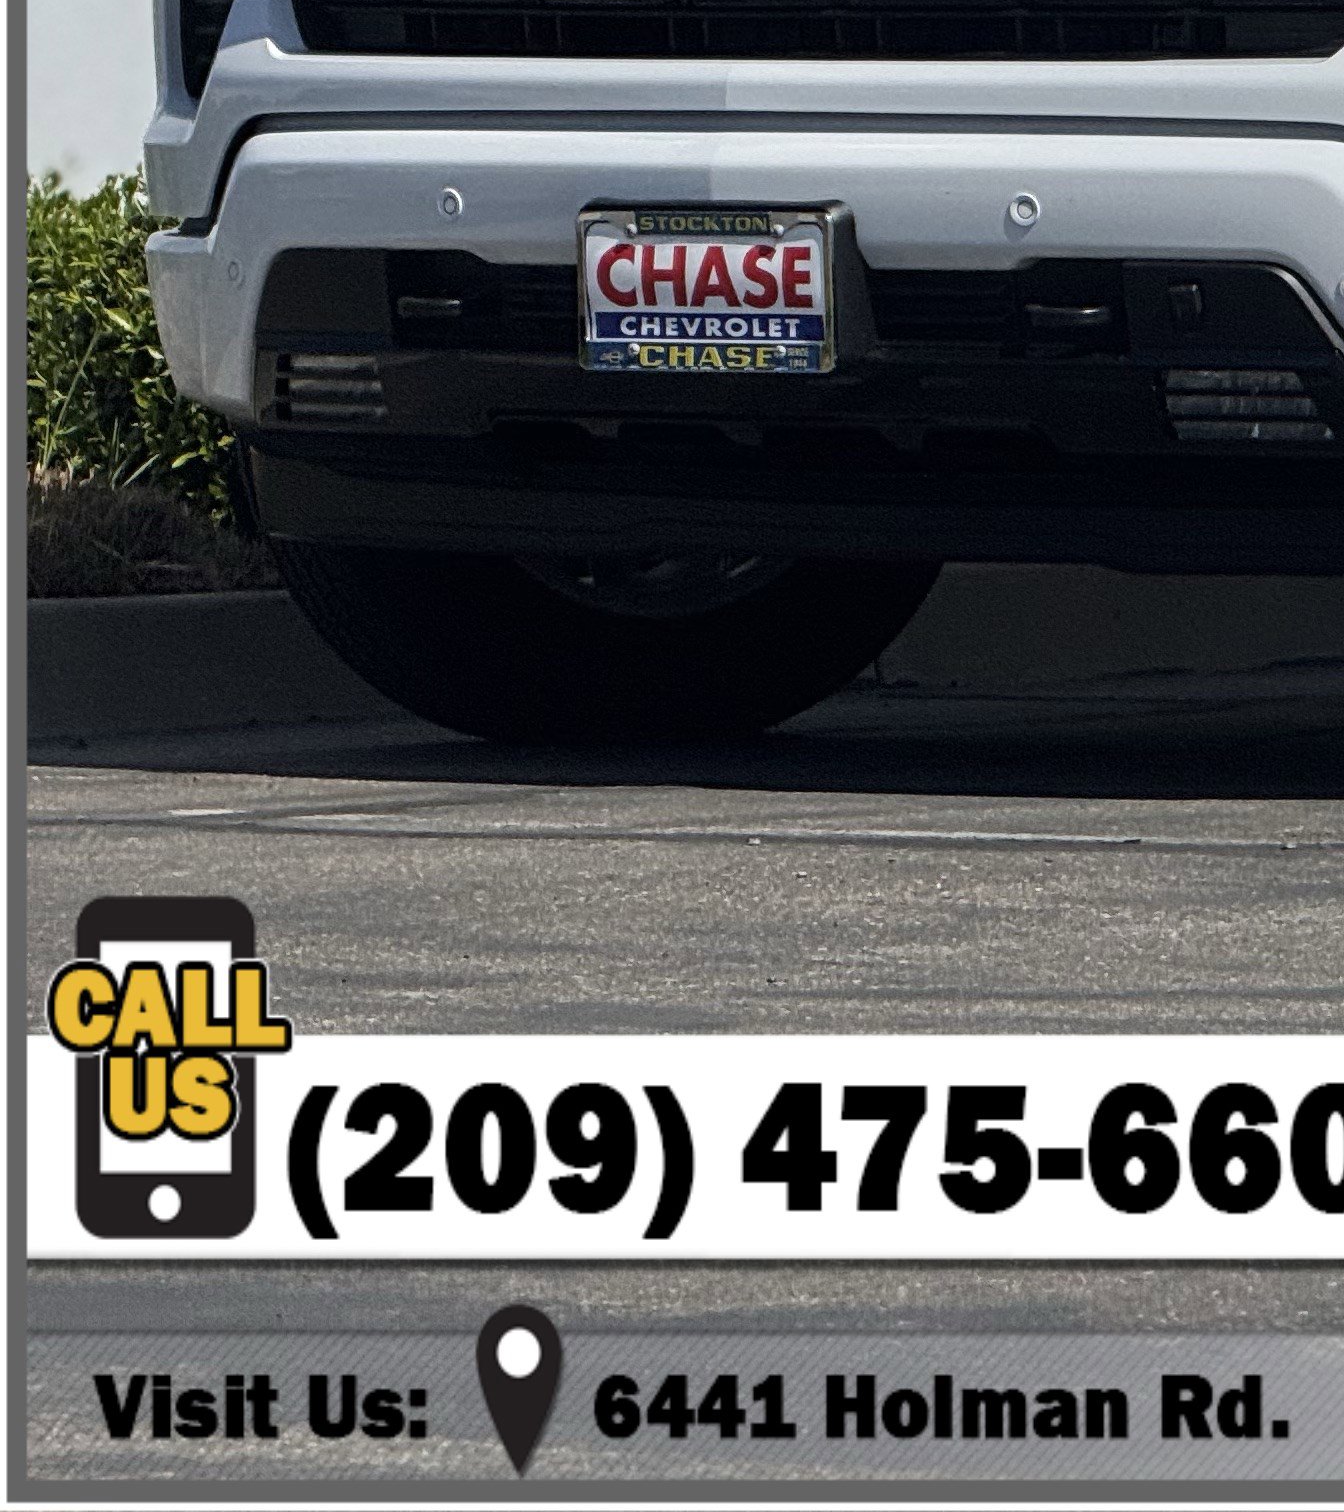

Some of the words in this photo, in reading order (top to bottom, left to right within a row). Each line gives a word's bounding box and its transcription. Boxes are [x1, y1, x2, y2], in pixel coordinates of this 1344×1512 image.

[639, 213, 769, 233] STOCKTON
[597, 243, 814, 308] CHASE
[620, 316, 800, 338] CHEVROLET
[640, 345, 779, 368] CHASE
